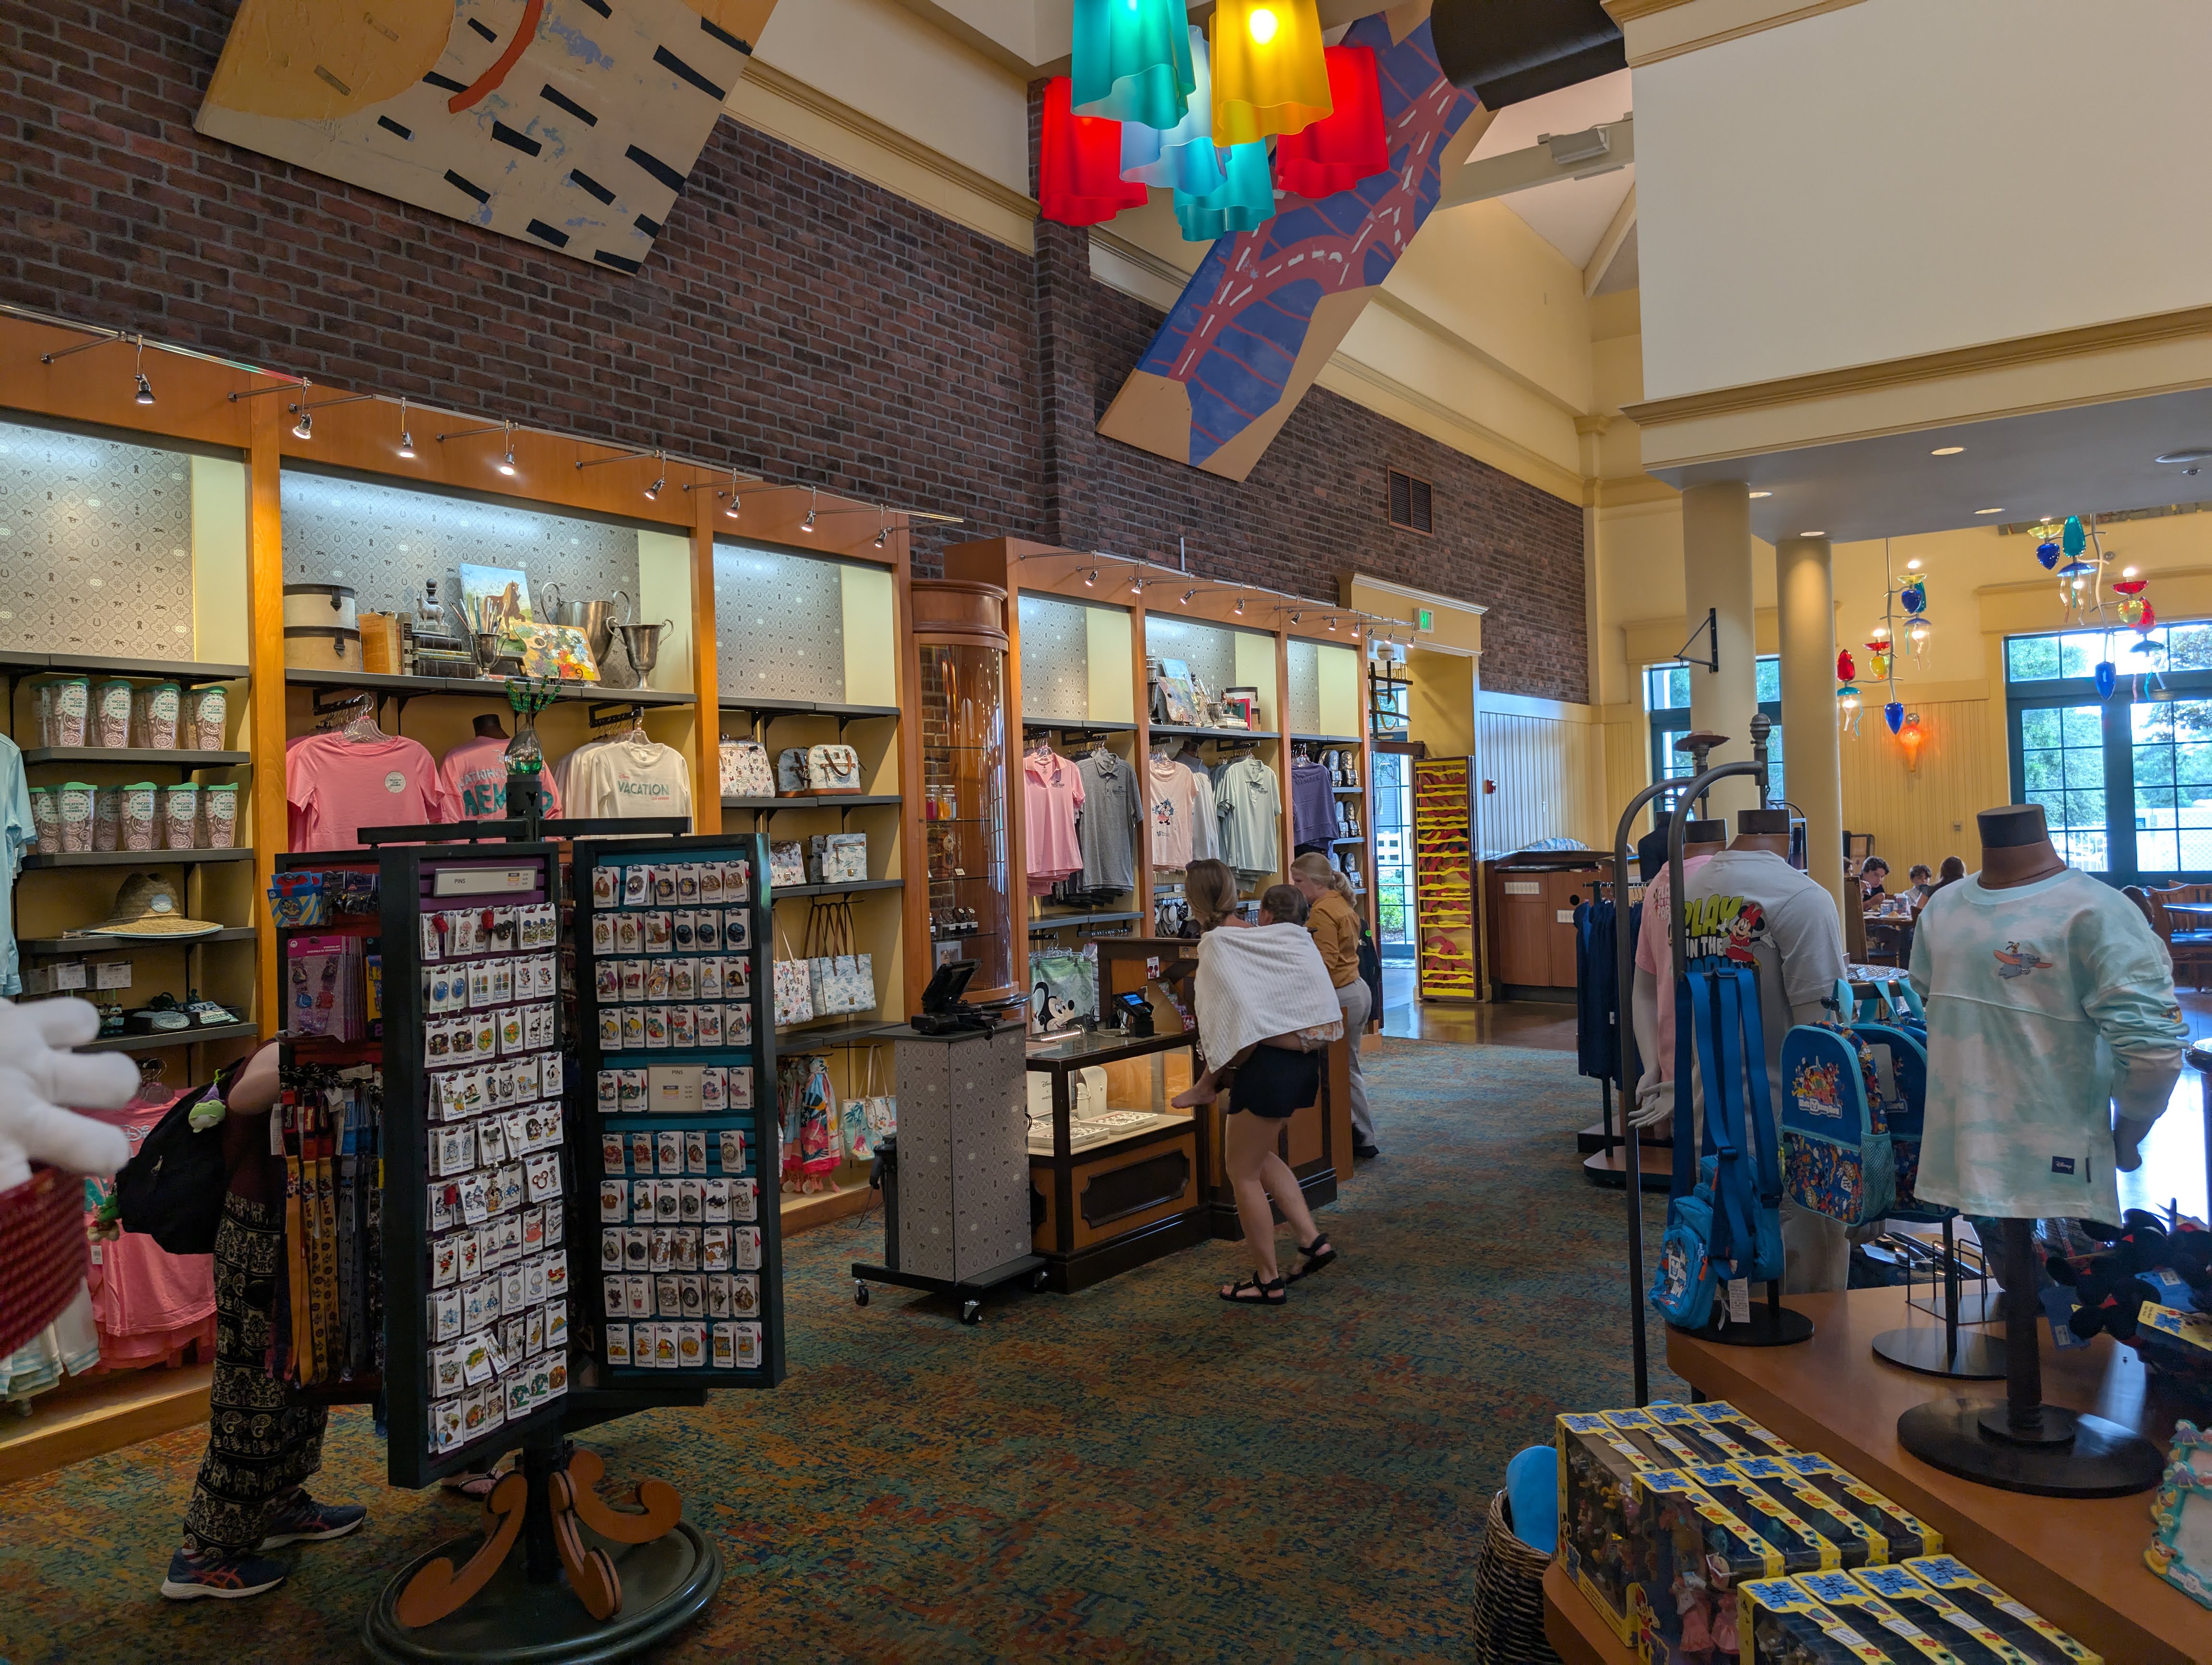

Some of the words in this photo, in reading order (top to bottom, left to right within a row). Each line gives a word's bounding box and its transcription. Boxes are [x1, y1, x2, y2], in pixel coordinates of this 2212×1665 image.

[618, 780, 670, 796] VACATION
[1294, 775, 1320, 786] MEMBER
[1657, 885, 1670, 899] PLA
[1657, 905, 1670, 920] PAR
[1685, 894, 1744, 937] PLAY
[1686, 928, 1698, 958] IN
[1700, 936, 1724, 956] THE
[2055, 1161, 2072, 1170] Disney
